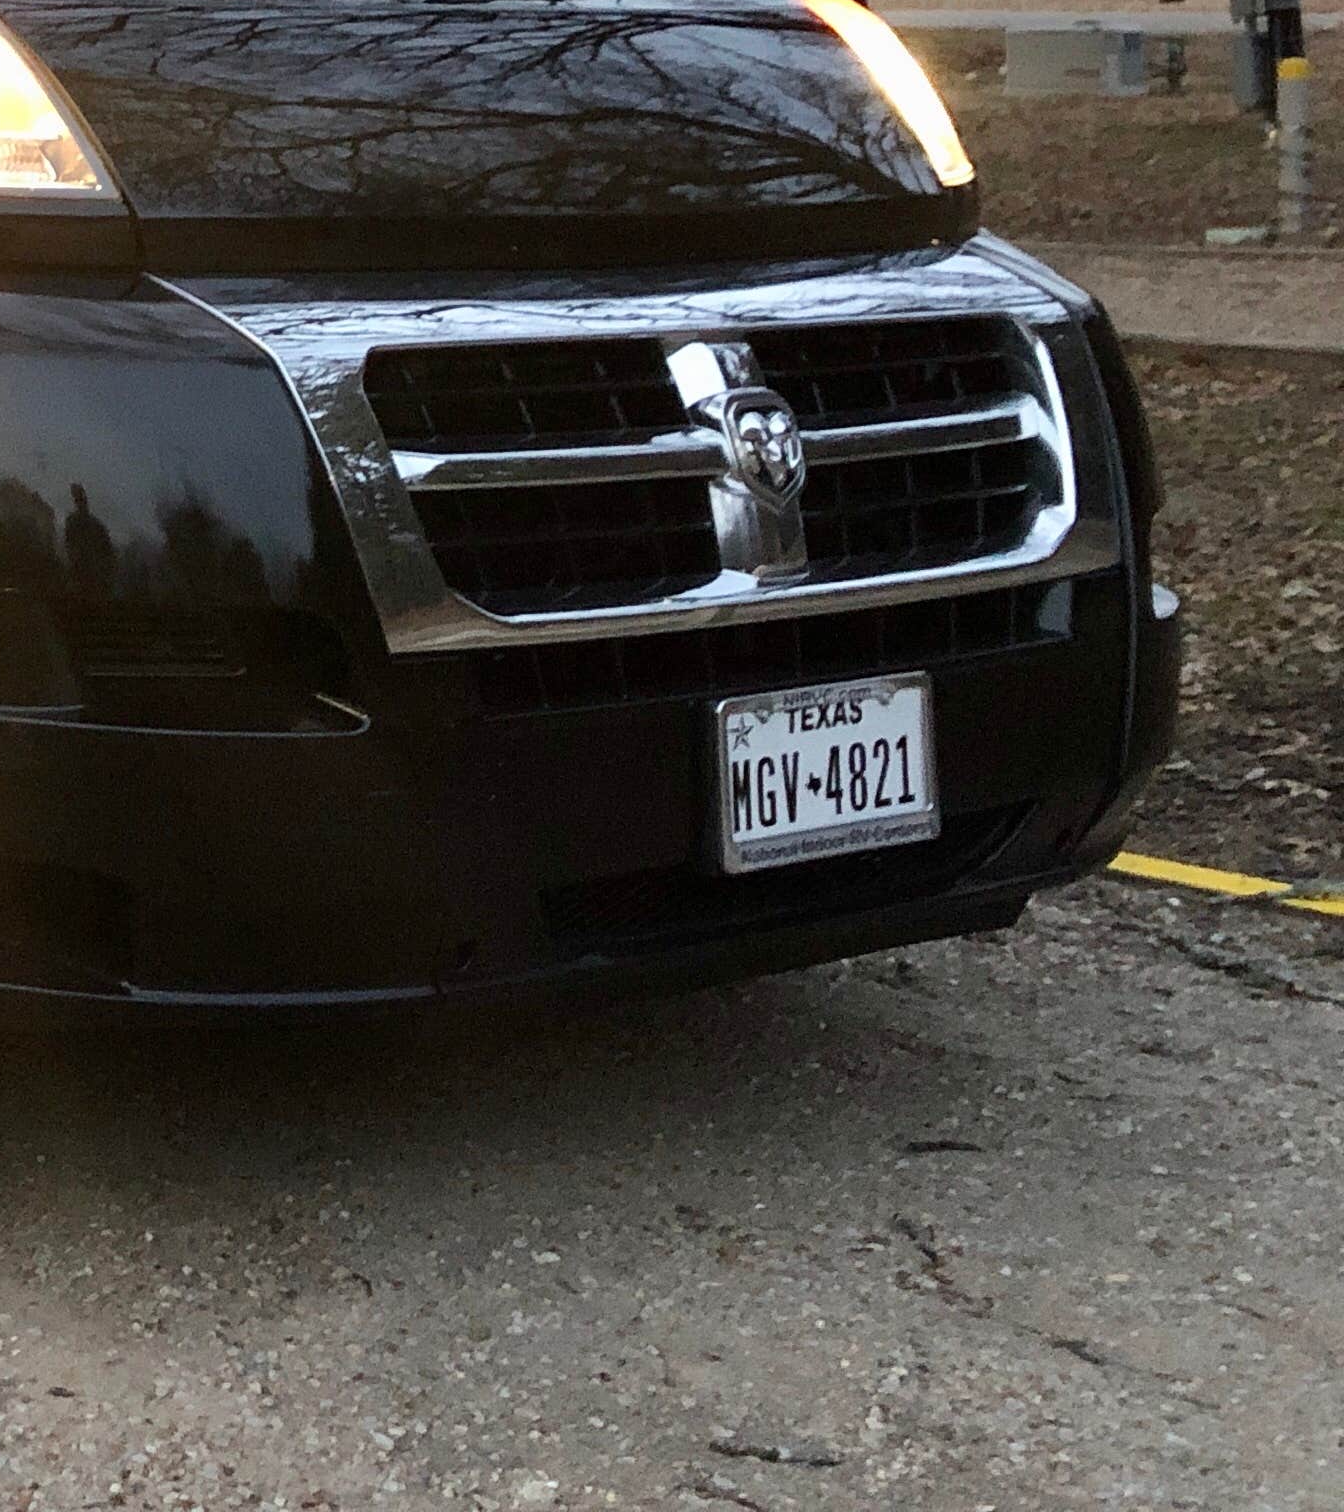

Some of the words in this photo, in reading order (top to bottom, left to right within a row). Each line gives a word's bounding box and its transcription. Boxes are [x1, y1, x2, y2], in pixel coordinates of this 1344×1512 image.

[786, 701, 863, 734] TEXAS
[732, 751, 800, 833] MGV
[826, 735, 916, 815] 4821
